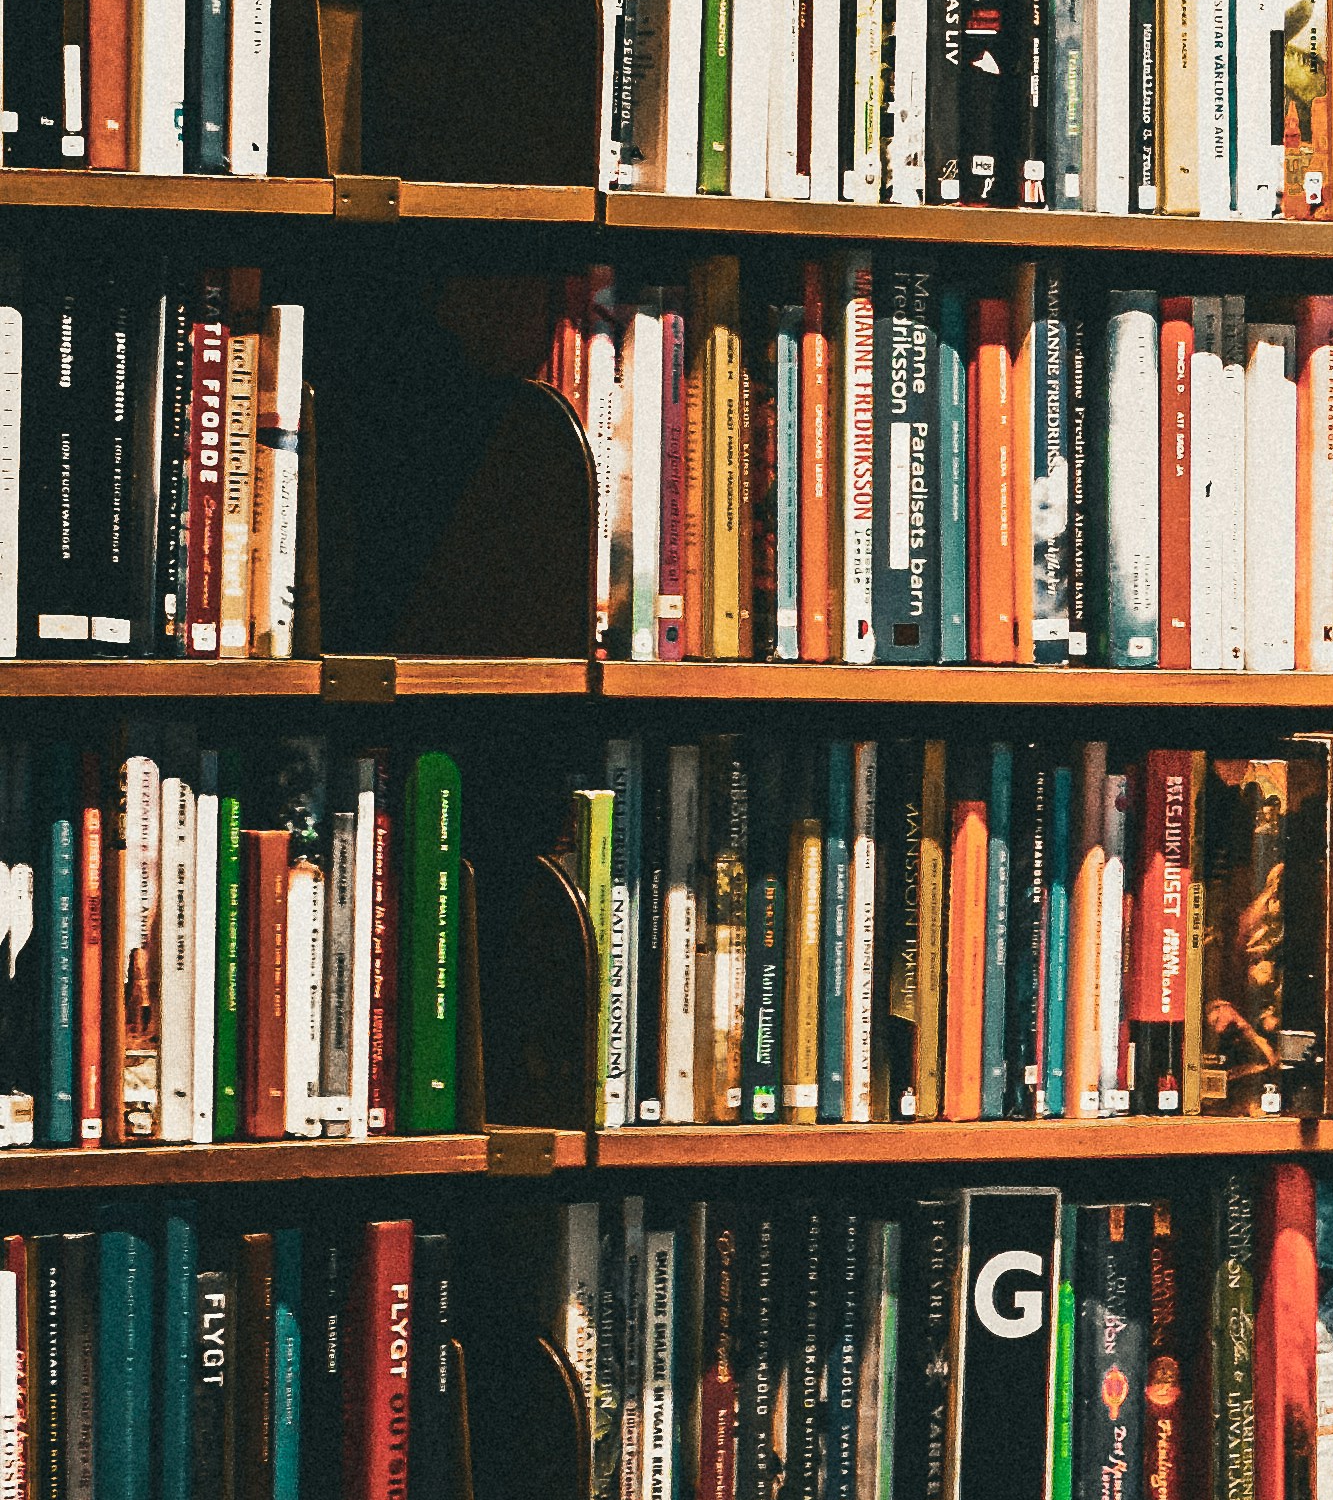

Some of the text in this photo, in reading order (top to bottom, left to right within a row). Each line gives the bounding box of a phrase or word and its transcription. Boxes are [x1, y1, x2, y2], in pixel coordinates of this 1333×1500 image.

[946, 31, 958, 65] LIV
[892, 271, 910, 413] Fredriksson
[1048, 281, 1059, 375] MARIANNE
[201, 287, 220, 483] KATIE FFORDE
[853, 269, 873, 521] MARIANNE FREDRIKSSON
[227, 395, 254, 514] Fichtelius
[911, 274, 928, 616] Marianne Paradisets barn
[1075, 407, 1085, 504] Fredriksson
[1164, 805, 1180, 916] SJUKHUSET
[761, 964, 775, 1005] Maria
[204, 1293, 224, 1387] FLYGT
[975, 1251, 1042, 1338] G
[652, 1457, 663, 1500] RIKARE
